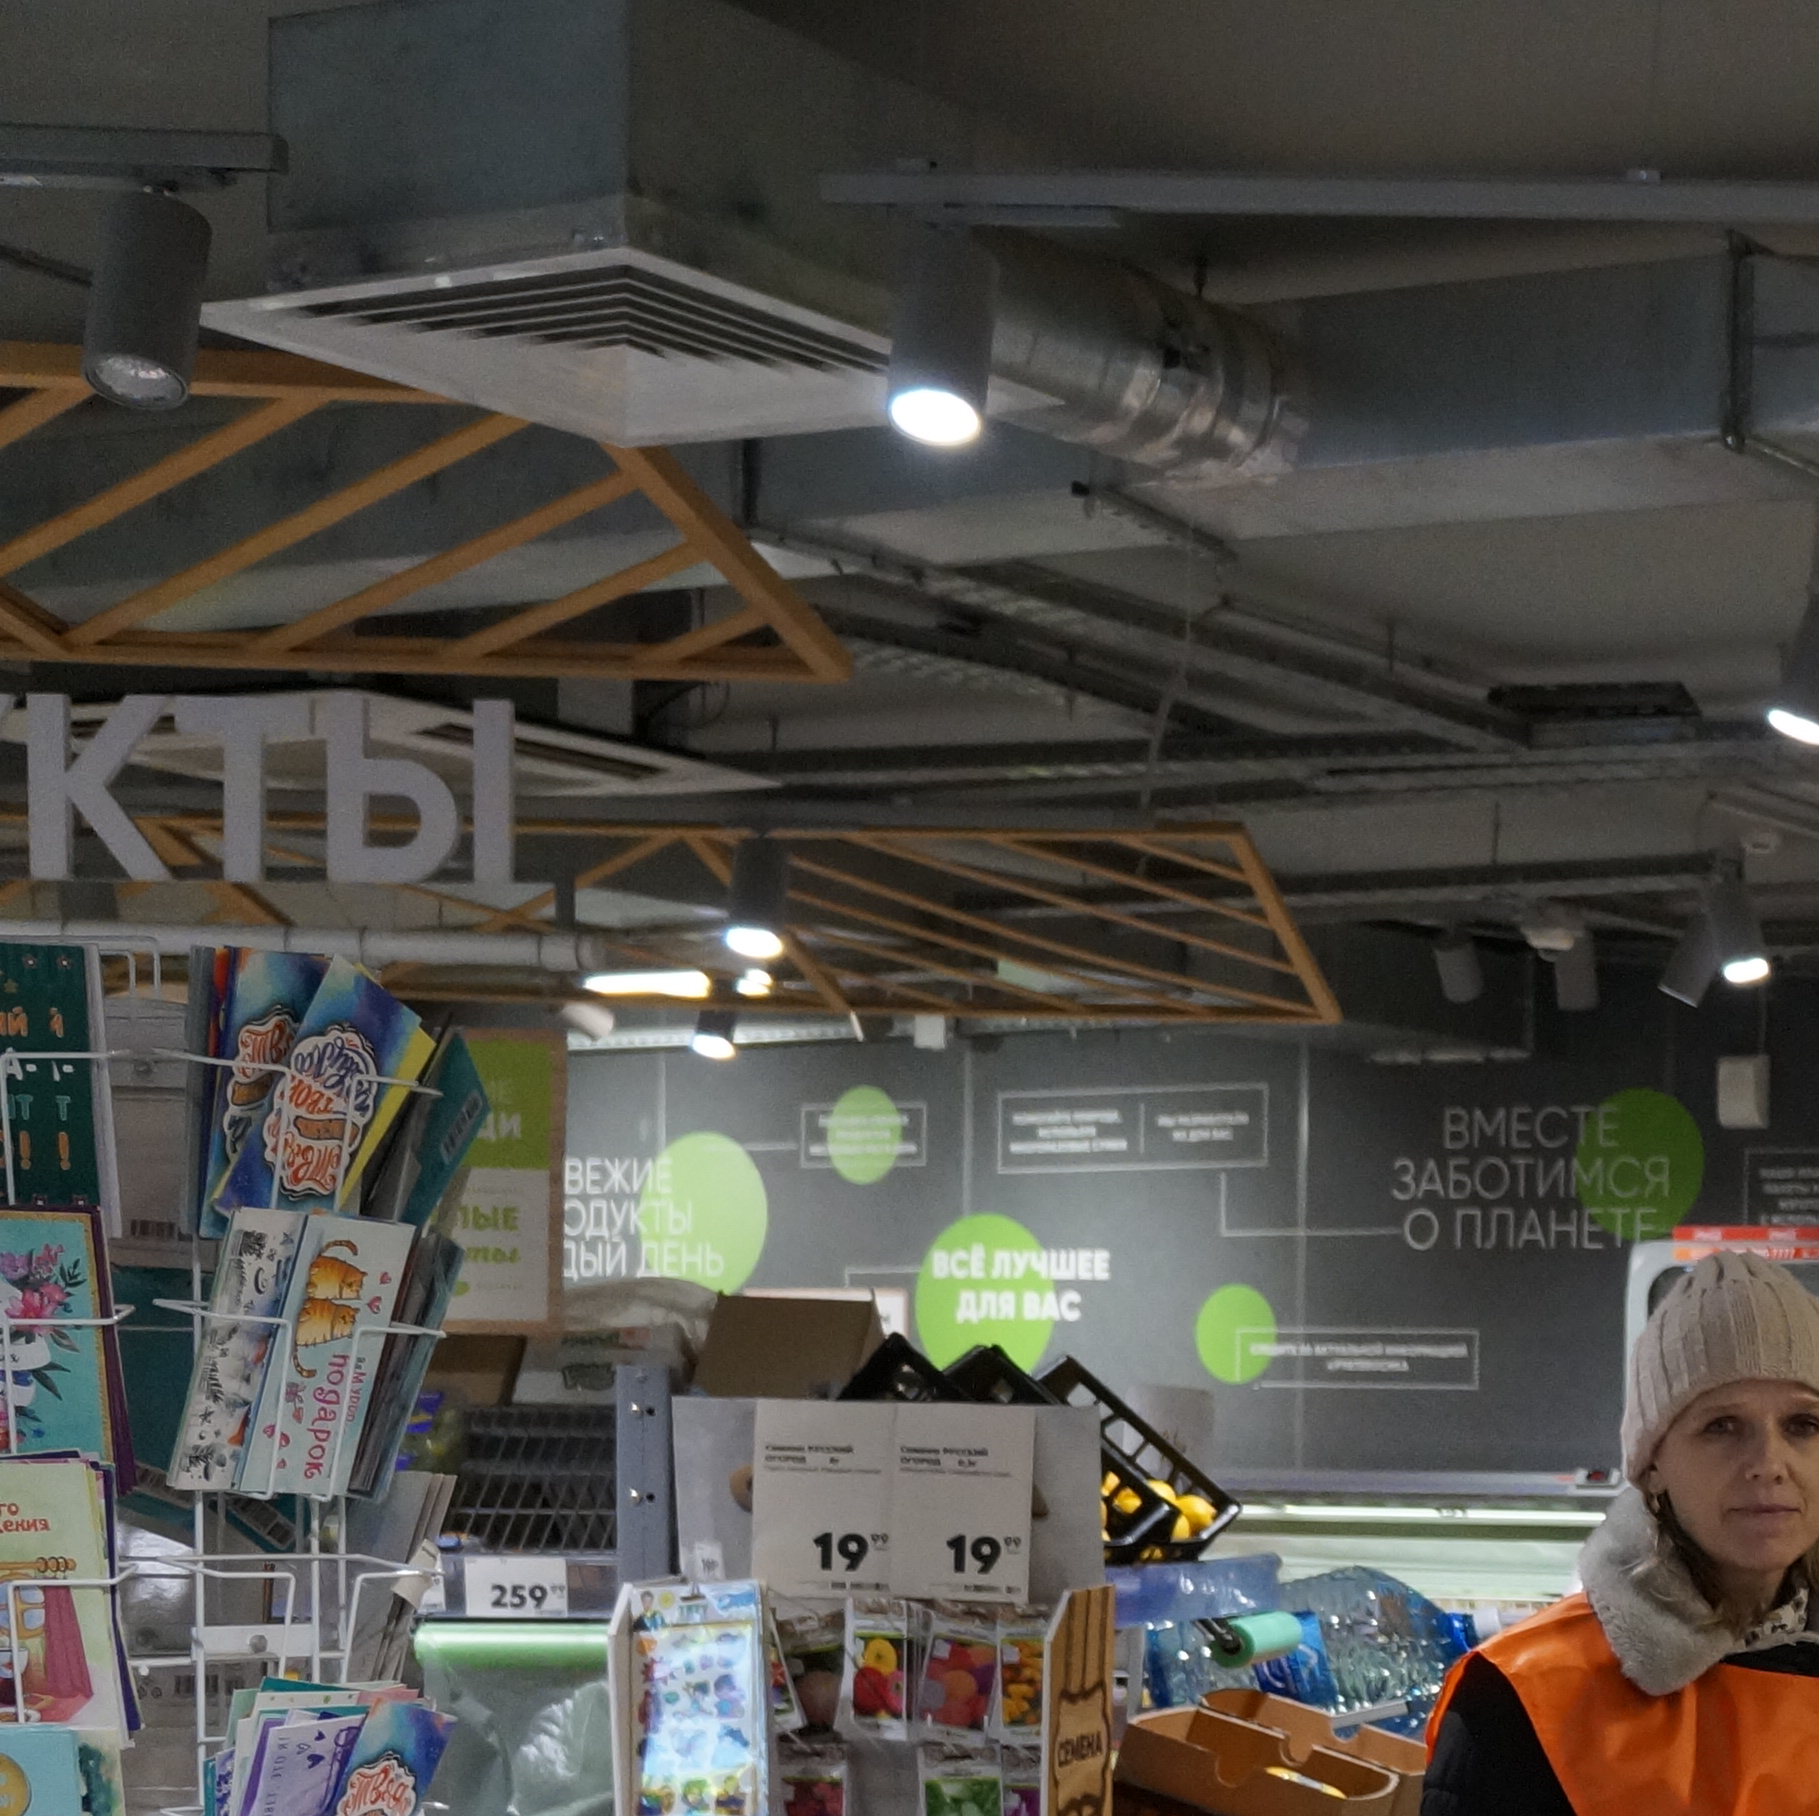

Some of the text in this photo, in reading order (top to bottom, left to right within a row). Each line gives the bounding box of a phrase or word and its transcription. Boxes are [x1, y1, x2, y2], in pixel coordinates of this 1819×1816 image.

[0, 693, 516, 884] КТЫ
[1444, 1104, 1618, 1149] ВМЕСТЕ
[1392, 1157, 1670, 1201] ЗАБОТИМСЯ
[1403, 1207, 1659, 1250] О ПЛАНЕТЕ
[637, 1241, 724, 1279] ДЕНЬ
[932, 1243, 1110, 1281] ВСЁ ЛУЧШЕЕ
[957, 1290, 1082, 1325] ДЛЯ ВАС
[303, 1354, 350, 1480] подарок
[813, 1530, 869, 1571] 19
[946, 1534, 1001, 1574] 19
[491, 1584, 549, 1608] 259
